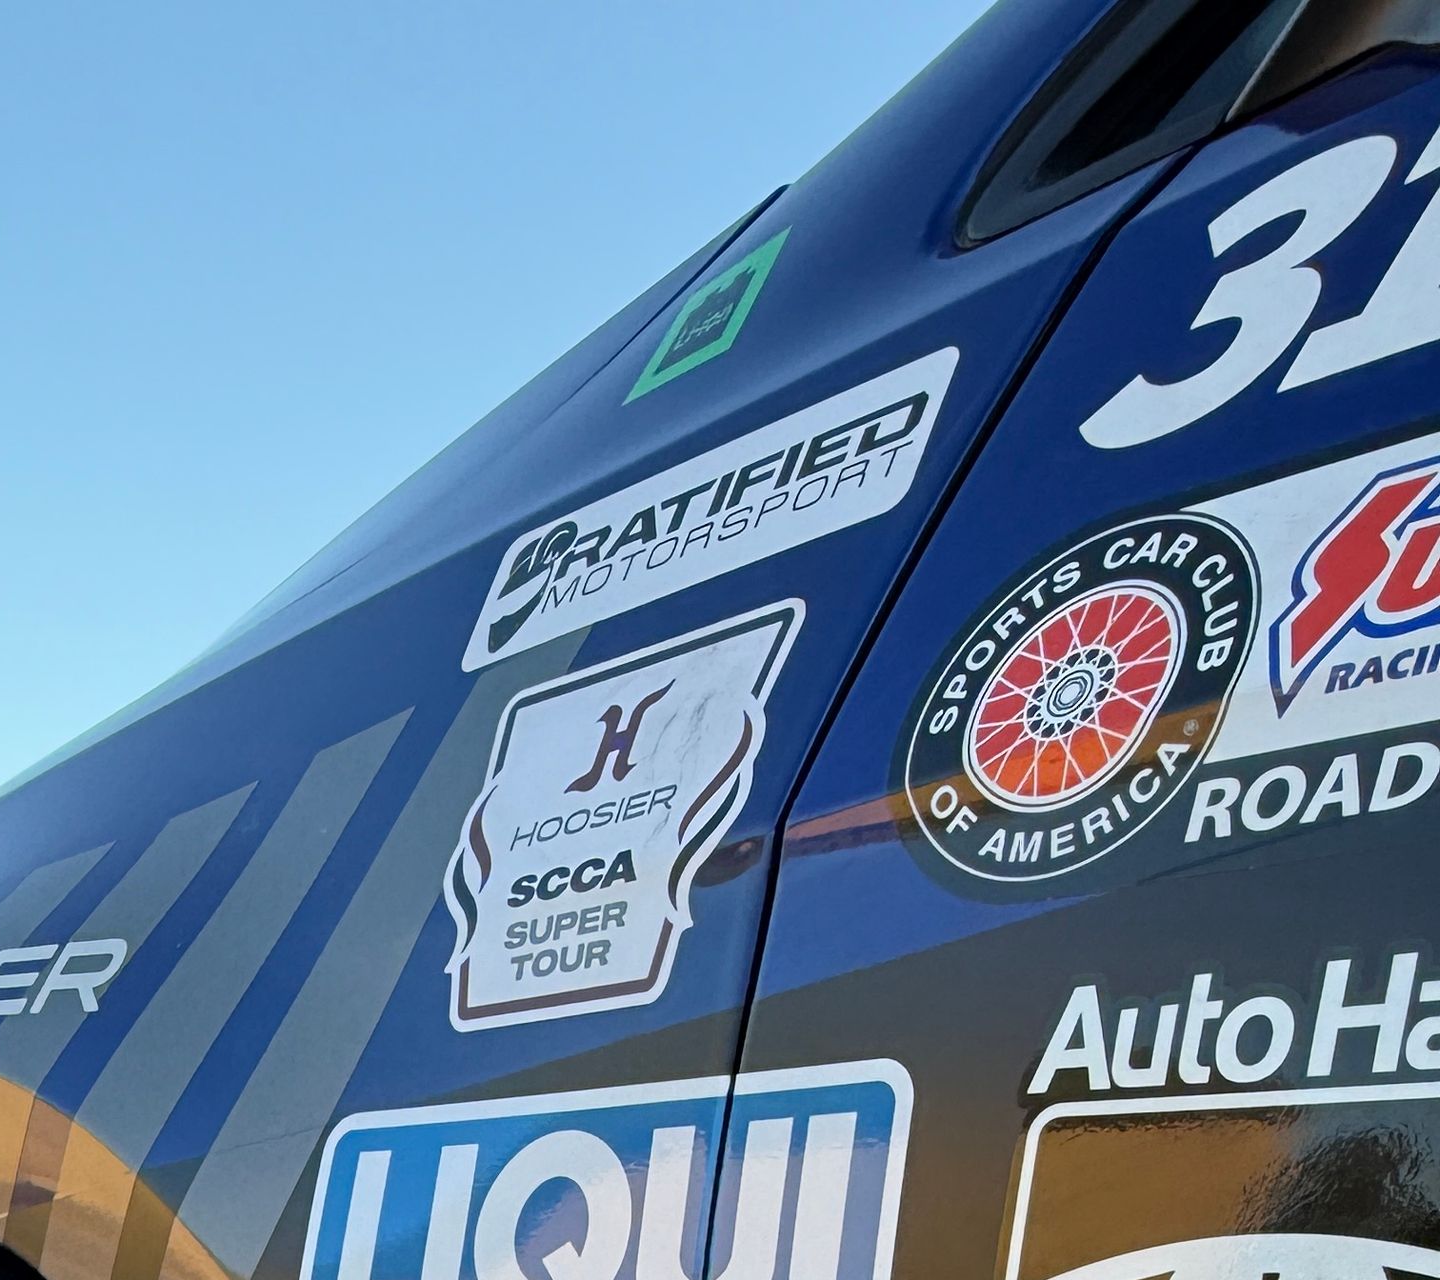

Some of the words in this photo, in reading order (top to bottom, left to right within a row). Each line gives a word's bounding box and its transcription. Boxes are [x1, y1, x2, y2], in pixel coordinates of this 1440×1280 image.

[540, 441, 913, 614] MOTORSPORT
[553, 391, 929, 583] RATIFIED
[929, 561, 1081, 734] SPORTS
[1103, 532, 1198, 569] CAR
[1192, 554, 1239, 672] CLUB
[510, 784, 678, 851] HOOSIER
[930, 784, 978, 833] OF
[978, 743, 1191, 863] AMERICA
[1184, 742, 1440, 843] ROAD
[503, 900, 628, 950] SUPER
[507, 849, 637, 908] SCCA
[510, 939, 611, 981] TOUR
[1028, 974, 1295, 1095] Auto
